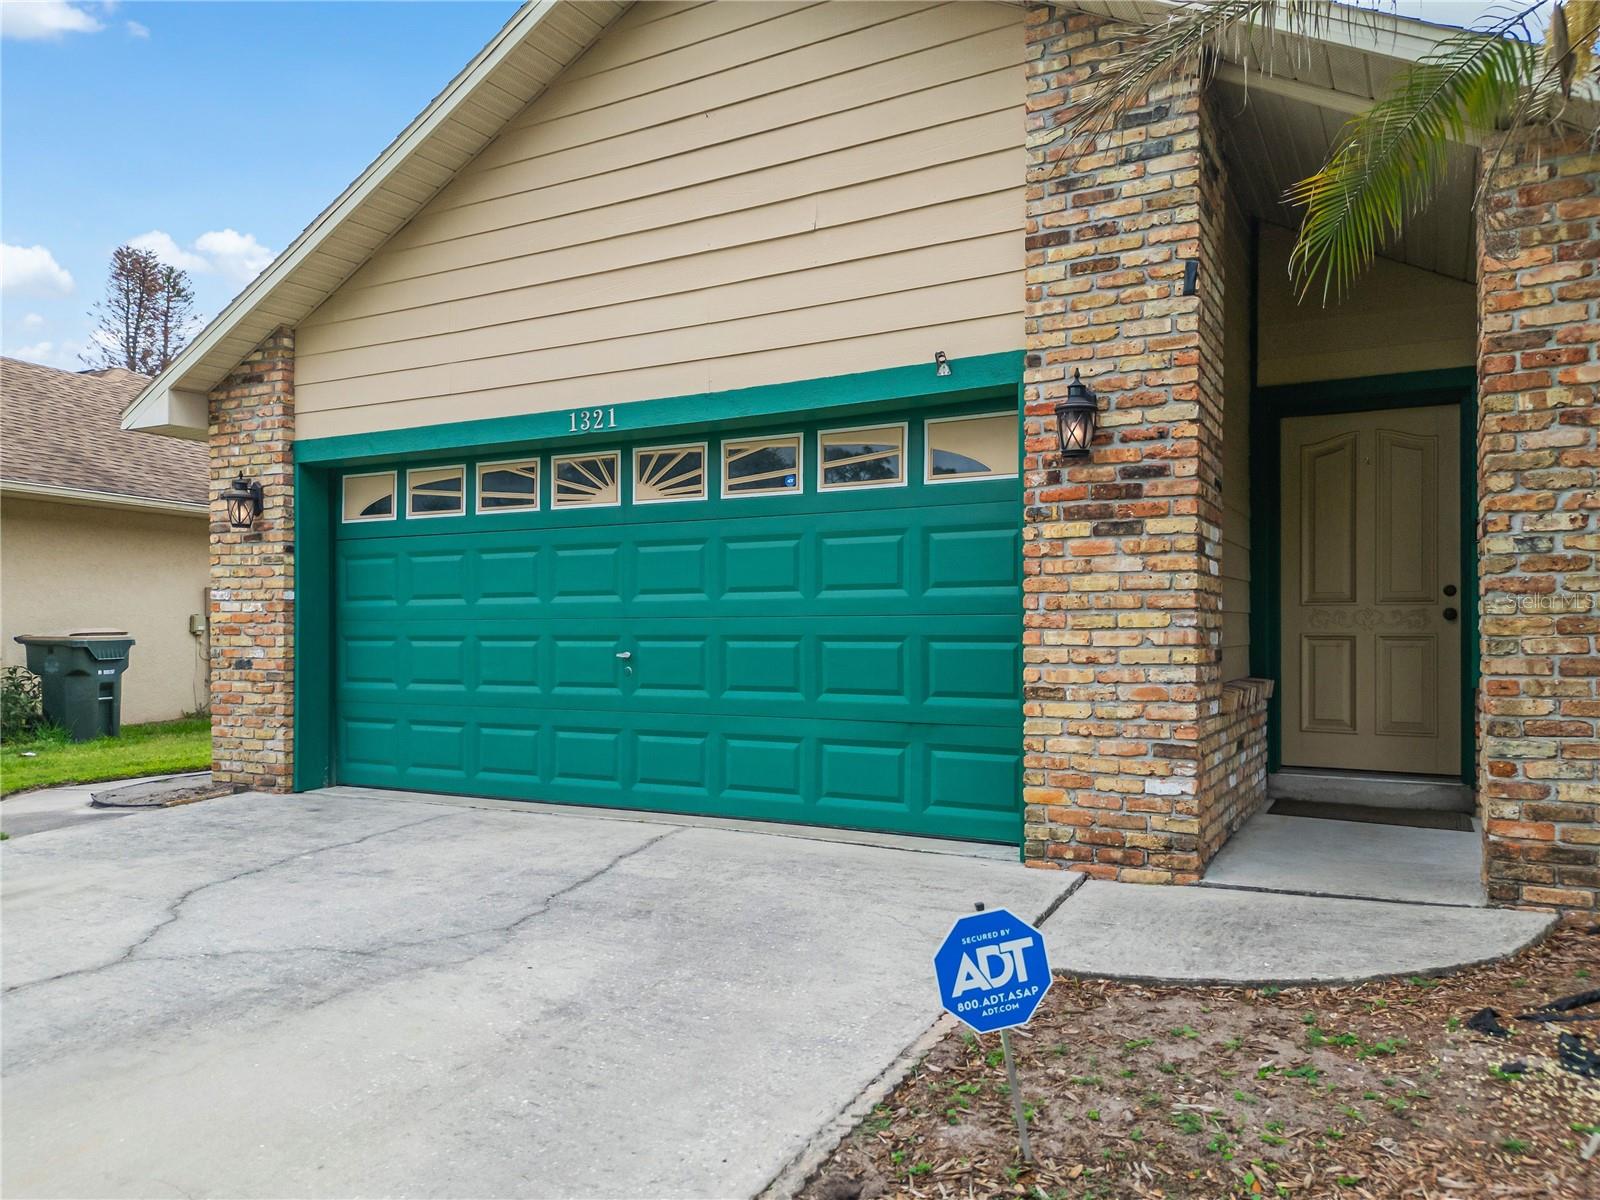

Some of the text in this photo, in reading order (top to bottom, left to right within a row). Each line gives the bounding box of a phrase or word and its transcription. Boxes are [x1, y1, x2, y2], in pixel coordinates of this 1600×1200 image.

[569, 408, 617, 432] 1321
[961, 928, 1011, 945] SECURED BY
[951, 936, 1034, 998] ADT
[957, 985, 1039, 1012] 800.ADT.ASAP
[981, 1002, 1020, 1017] ADT.COM
